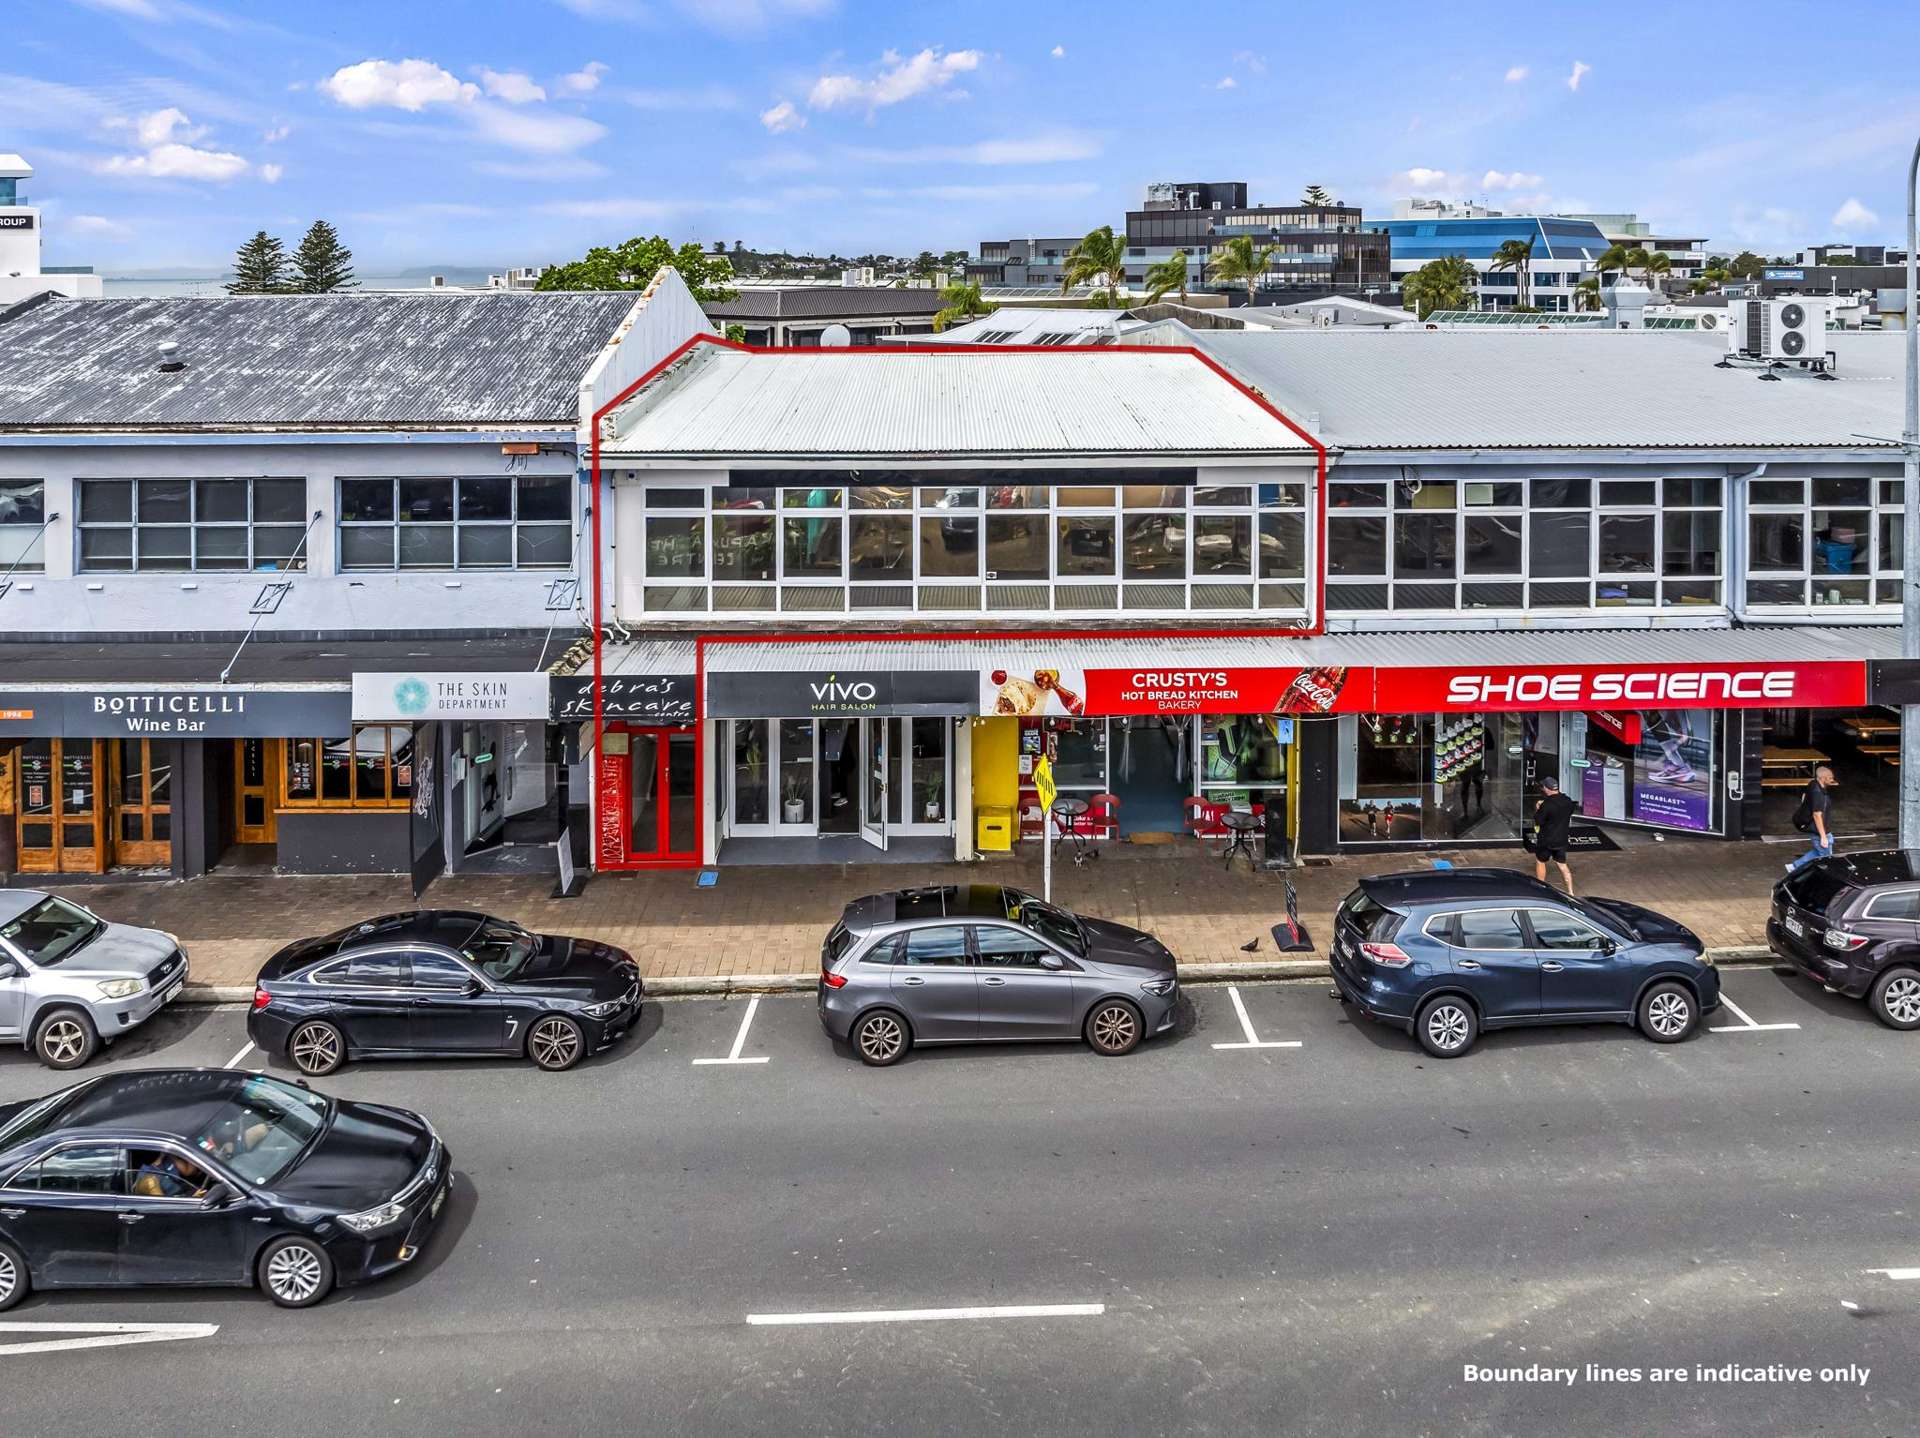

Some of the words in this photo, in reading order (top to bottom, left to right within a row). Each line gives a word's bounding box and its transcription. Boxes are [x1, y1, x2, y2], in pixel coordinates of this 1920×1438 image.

[1132, 672, 1228, 688] CRUSTY'S
[438, 682, 464, 697] THE
[472, 682, 507, 697] SKIN
[1447, 674, 1583, 702] SHOE
[1591, 671, 1796, 700] SCIENCE
[1121, 691, 1145, 700] HOT
[1147, 690, 1187, 700] BREAD
[1189, 690, 1239, 699] KITCHEN
[93, 696, 245, 714] BOTTICELLI
[439, 699, 507, 710] DEPARTMENT
[811, 703, 837, 711] HAIR
[840, 703, 877, 711] SALON
[1158, 700, 1202, 710] BAKERY
[3, 710, 22, 718] 1994
[126, 718, 171, 732] Wine
[177, 718, 206, 732] Bar
